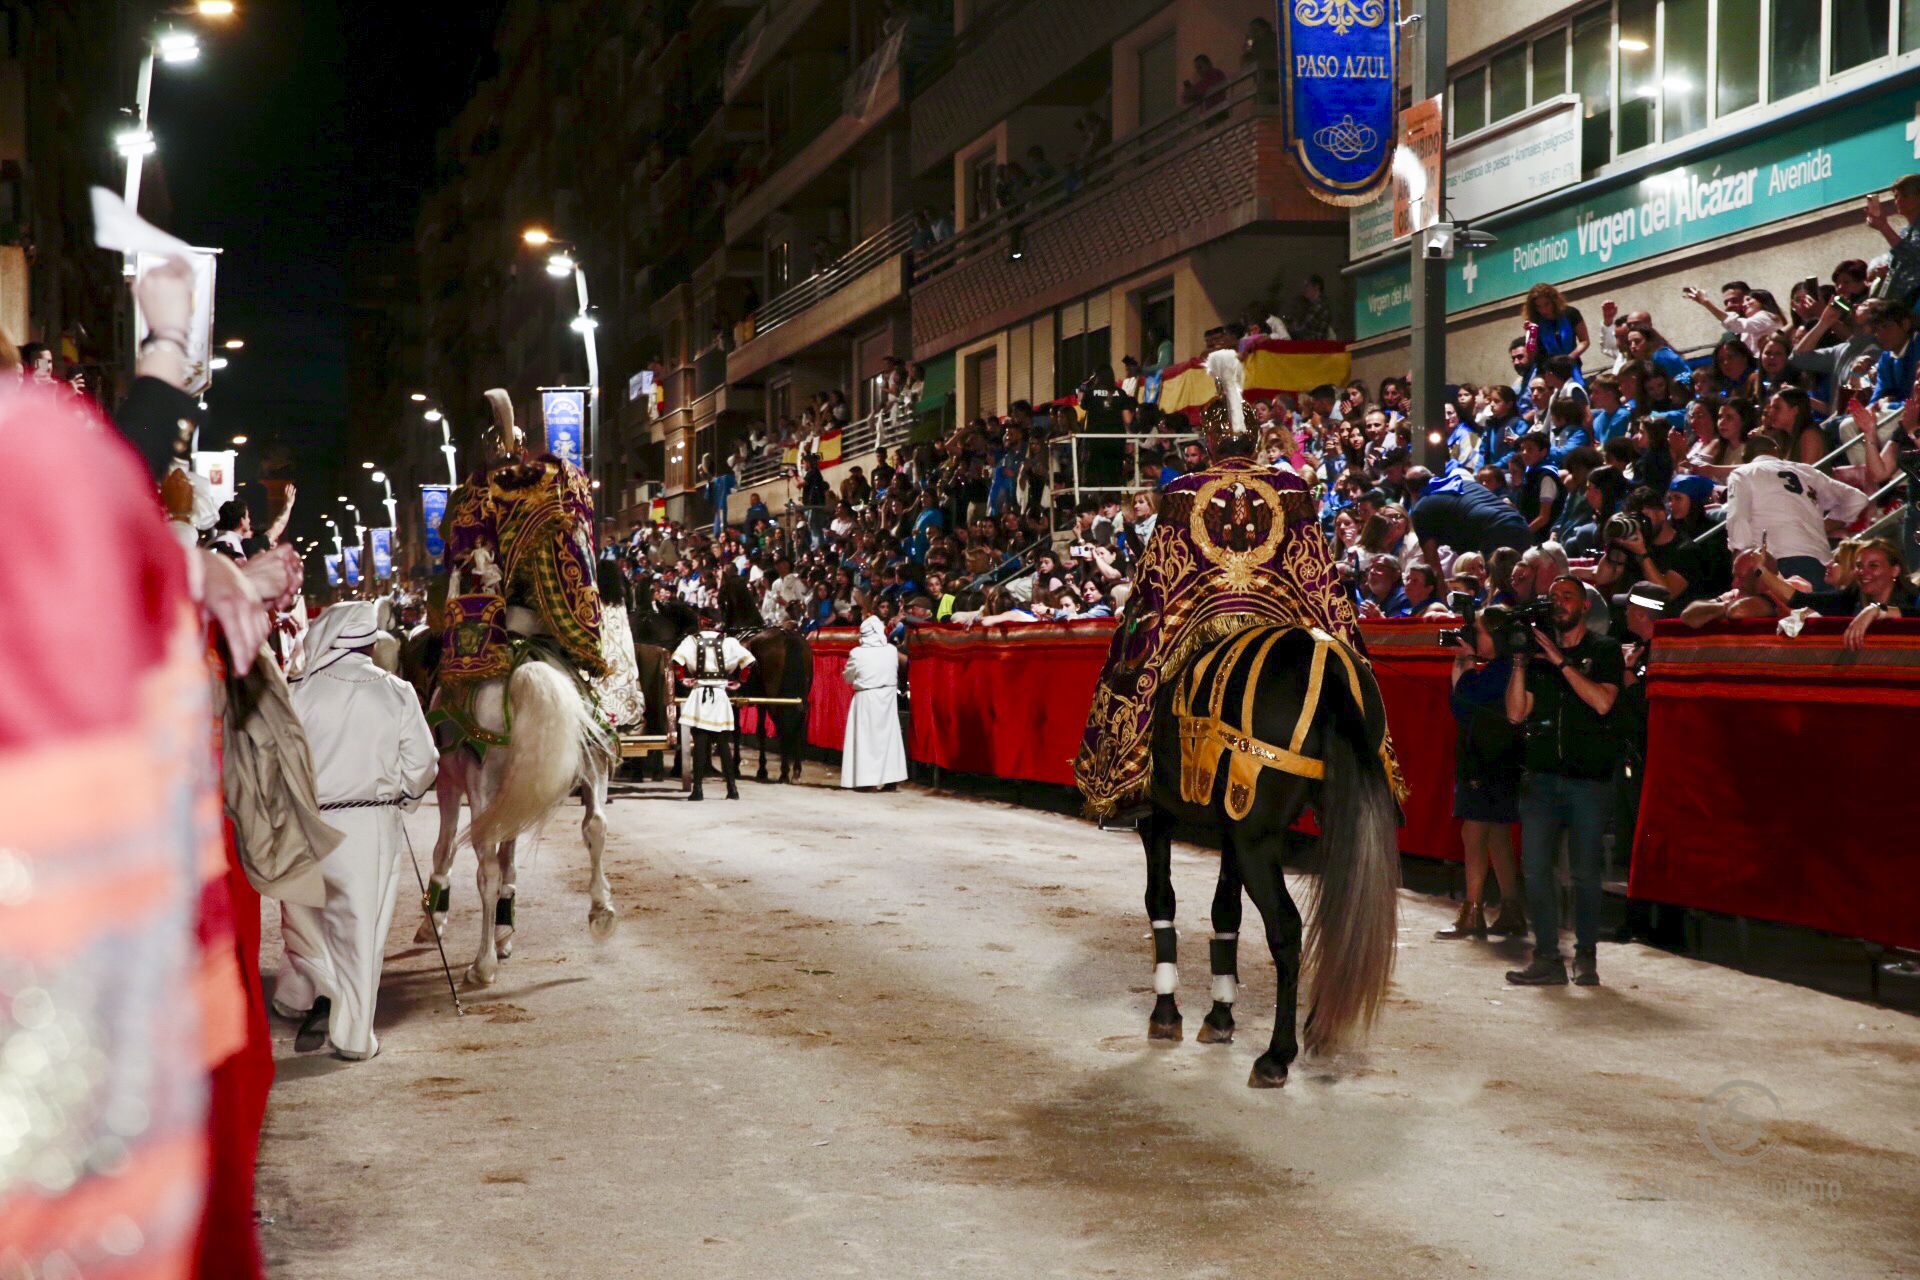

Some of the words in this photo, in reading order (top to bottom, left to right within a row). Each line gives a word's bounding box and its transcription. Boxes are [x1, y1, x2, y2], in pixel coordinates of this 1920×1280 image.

[1296, 54, 1339, 78] PASO
[1342, 54, 1389, 79] AZUL
[1513, 237, 1569, 273] Policlínico
[1577, 211, 1636, 262] Virgen
[1640, 180, 1672, 236] del
[1674, 163, 1759, 226] Alcázar
[1768, 147, 1833, 197] Avenida
